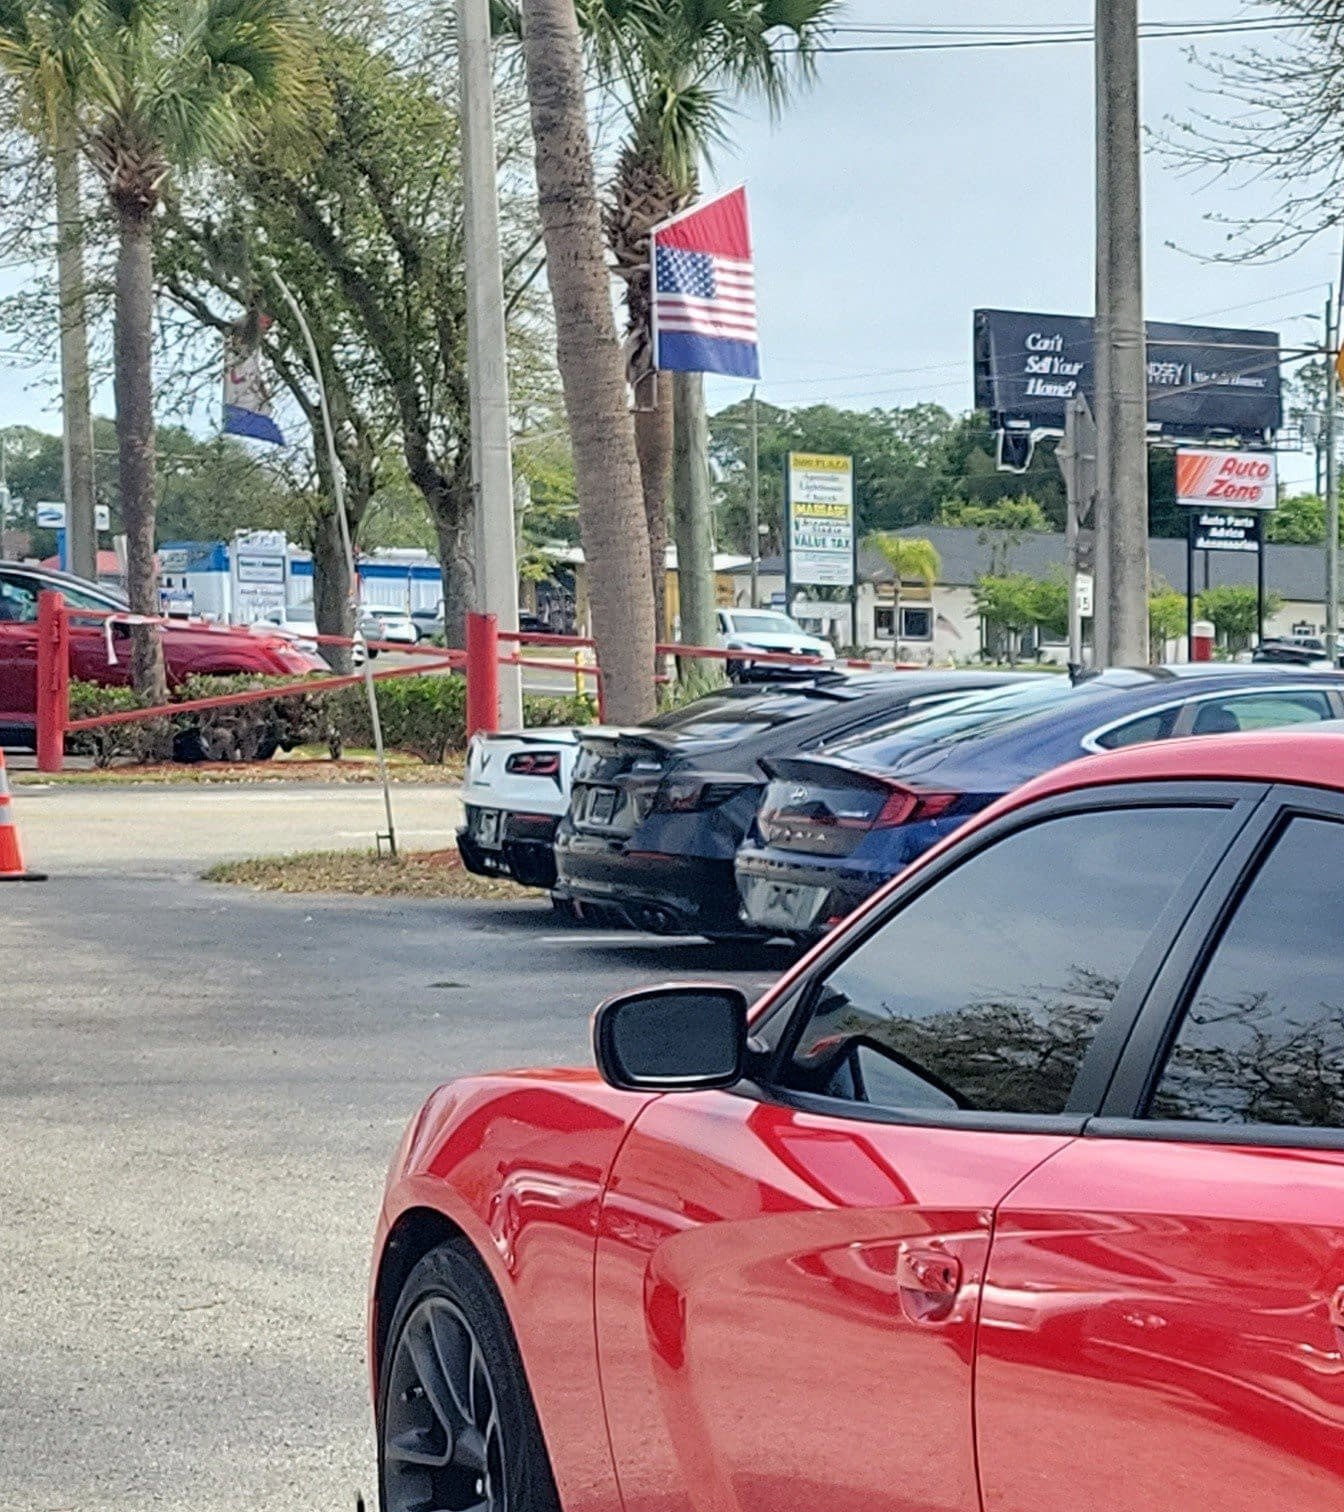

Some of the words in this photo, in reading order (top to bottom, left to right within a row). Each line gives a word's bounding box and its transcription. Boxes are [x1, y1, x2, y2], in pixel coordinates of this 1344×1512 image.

[1026, 333, 1063, 351] Can't
[1025, 355, 1052, 373] Sell
[1052, 357, 1083, 375] Your
[1025, 378, 1076, 397] Home?
[1220, 457, 1270, 477] Auto
[1206, 479, 1261, 499] Zone
